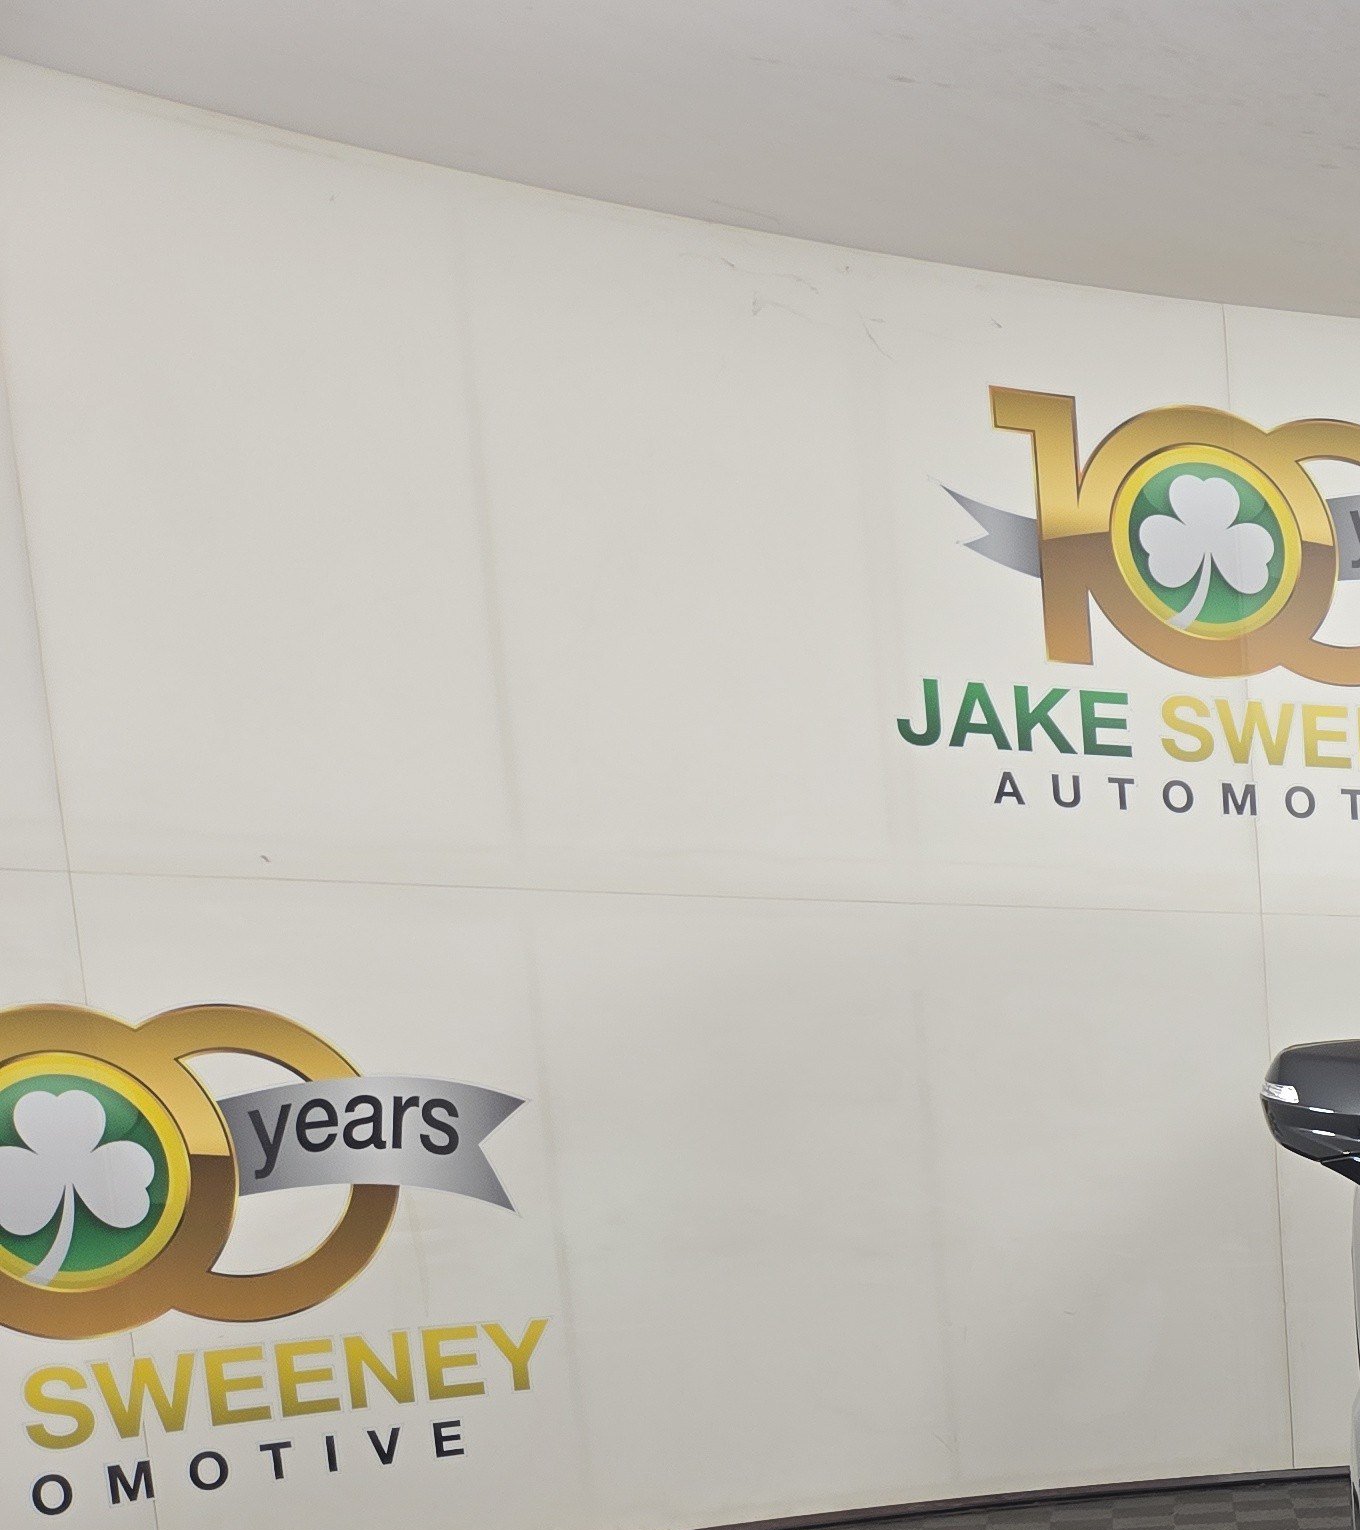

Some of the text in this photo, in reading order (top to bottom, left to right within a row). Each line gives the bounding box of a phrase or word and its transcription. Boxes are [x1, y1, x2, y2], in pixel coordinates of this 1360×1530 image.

[897, 678, 1133, 758] JAKE
[248, 1094, 459, 1179] years
[23, 1319, 549, 1450] SWEENEY
